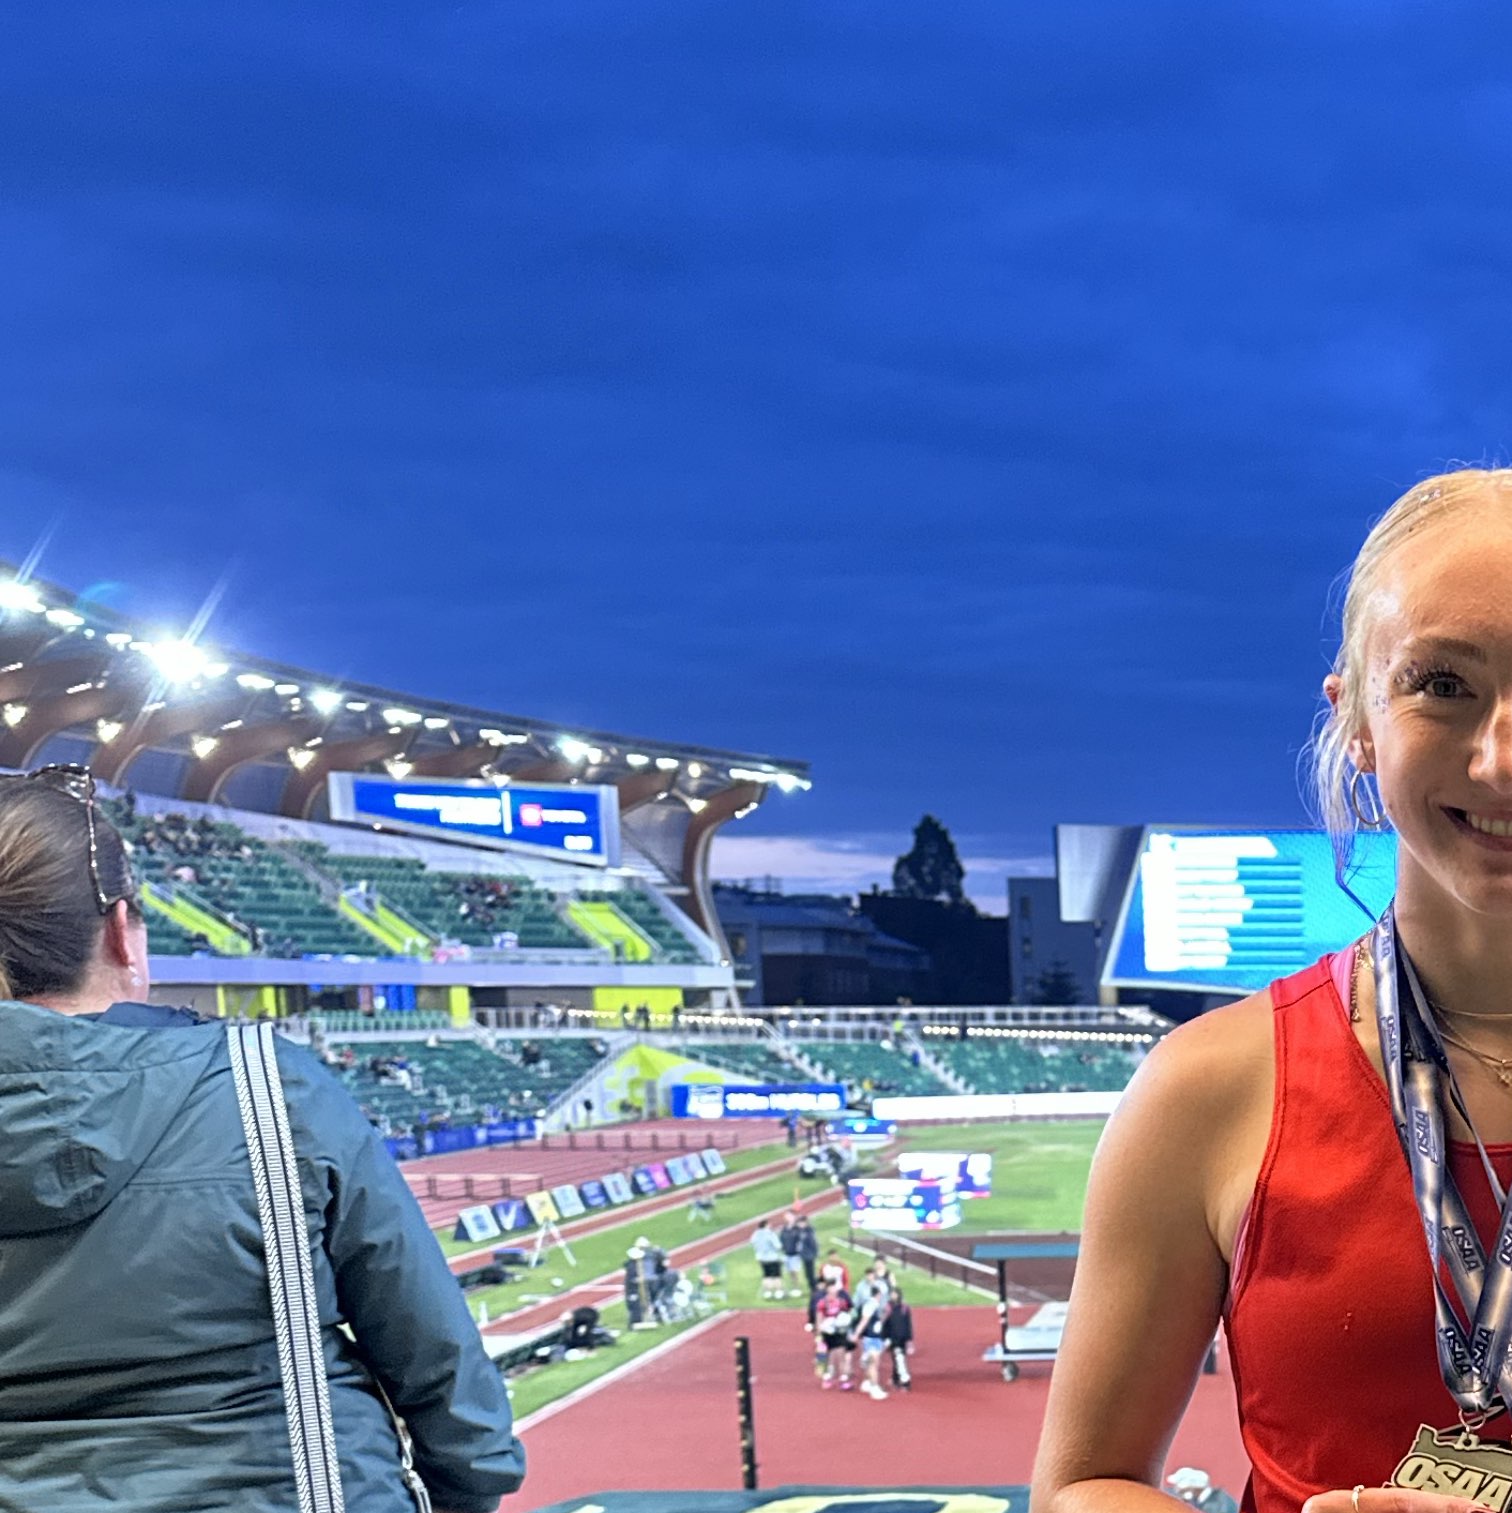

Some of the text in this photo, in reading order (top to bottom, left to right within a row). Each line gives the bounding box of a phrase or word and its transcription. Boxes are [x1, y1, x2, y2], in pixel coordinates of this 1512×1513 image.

[1416, 1109, 1429, 1157] OSAA
[1452, 1226, 1480, 1272] OSAA
[1445, 1327, 1472, 1375] OSAA
[1471, 1327, 1492, 1374] OSAA
[1395, 1455, 1512, 1513] OSAA
